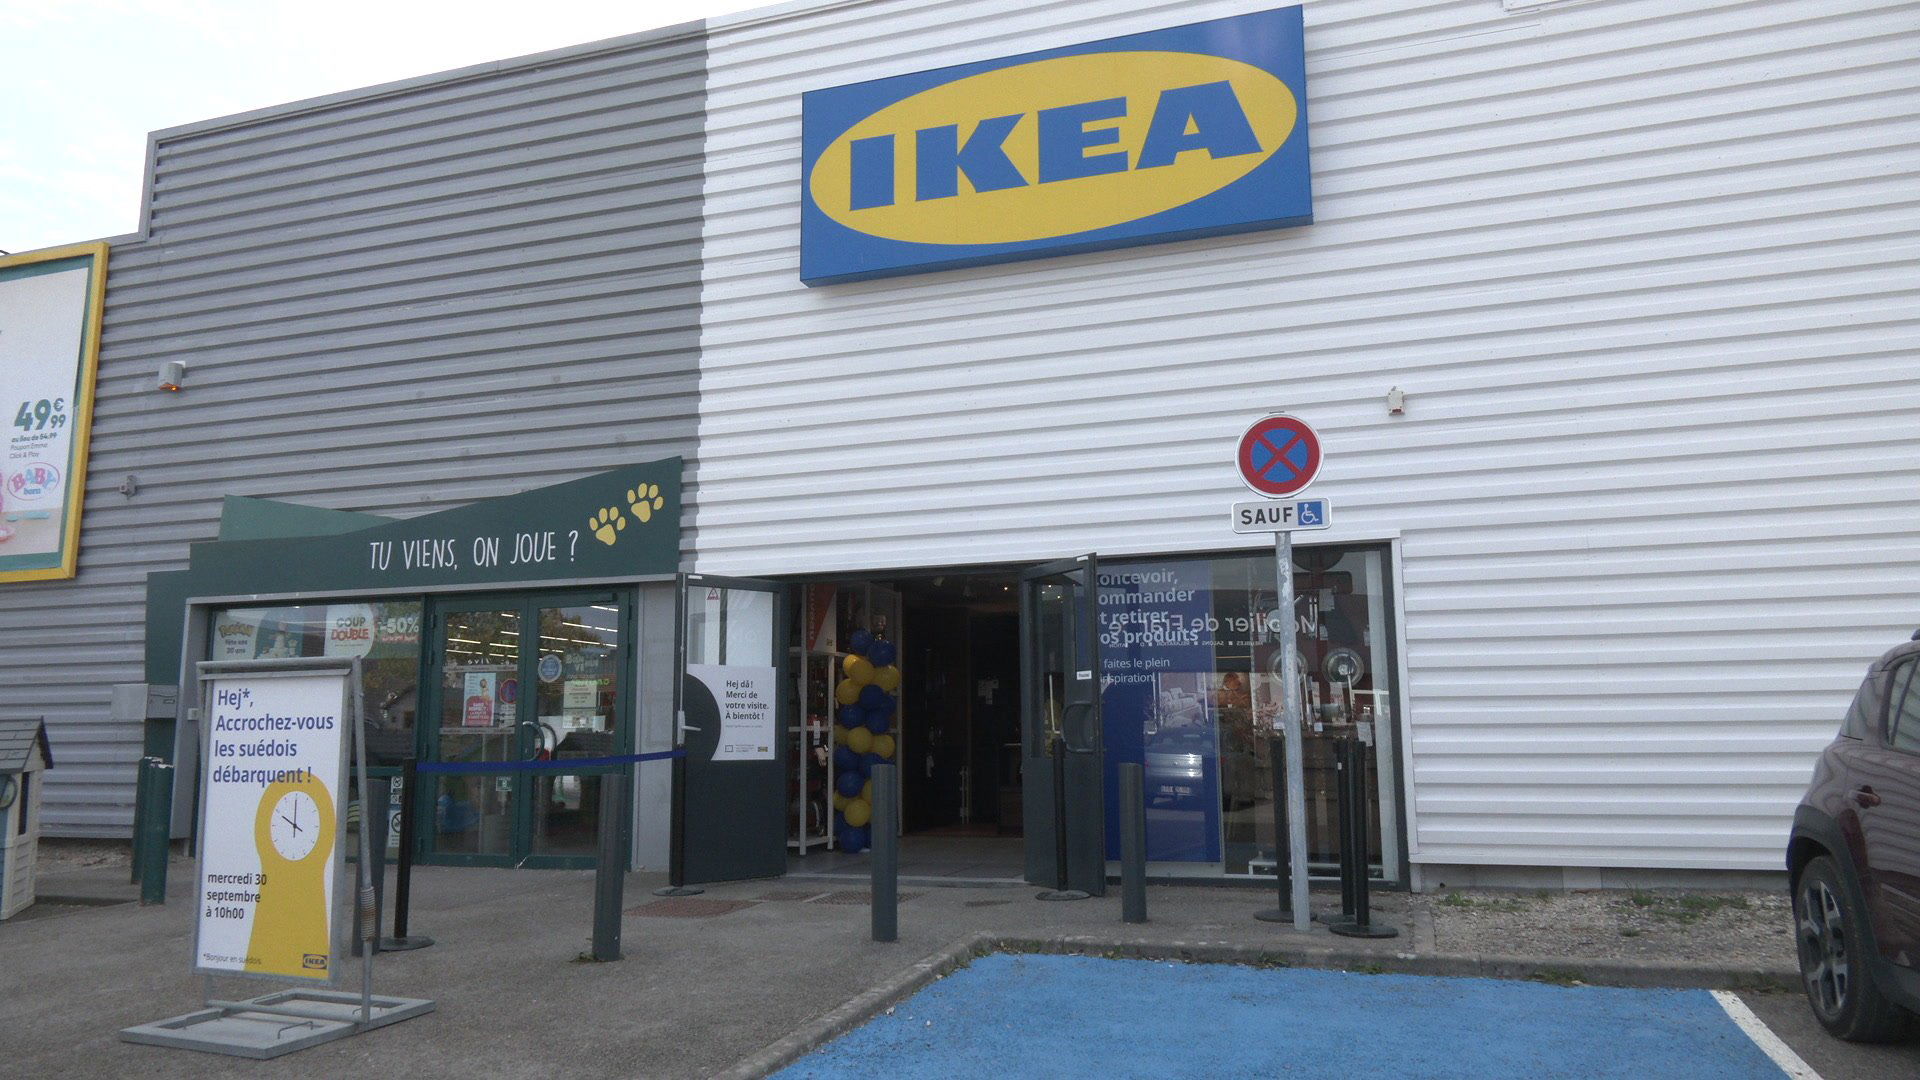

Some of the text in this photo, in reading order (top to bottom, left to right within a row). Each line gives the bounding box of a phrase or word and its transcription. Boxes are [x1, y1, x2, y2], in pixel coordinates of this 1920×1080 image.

[850, 80, 1264, 211] IKEA
[1241, 506, 1293, 525] SAUF
[370, 530, 579, 571] TU VIENS, ON JOUE ?
[1097, 568, 1178, 586] oncevoir,
[1098, 587, 1195, 605] ommander
[336, 616, 366, 627] COUP
[1098, 609, 1169, 625] t retirer
[331, 628, 369, 640] DOUBLE
[1099, 627, 1199, 648] os produits
[1103, 658, 1170, 670] faites le plein
[726, 680, 738, 690] Hej
[726, 691, 758, 699] Merci de
[725, 702, 769, 710] votre visite.
[215, 713, 334, 731] Accrochez-vous
[725, 711, 731, 720] À
[732, 711, 760, 720] bientôt
[214, 739, 297, 757] les suédois
[213, 765, 312, 788] débarquent !
[208, 873, 267, 885] mercredi 30
[206, 890, 261, 904] septembre
[205, 906, 245, 919] à 10h00
